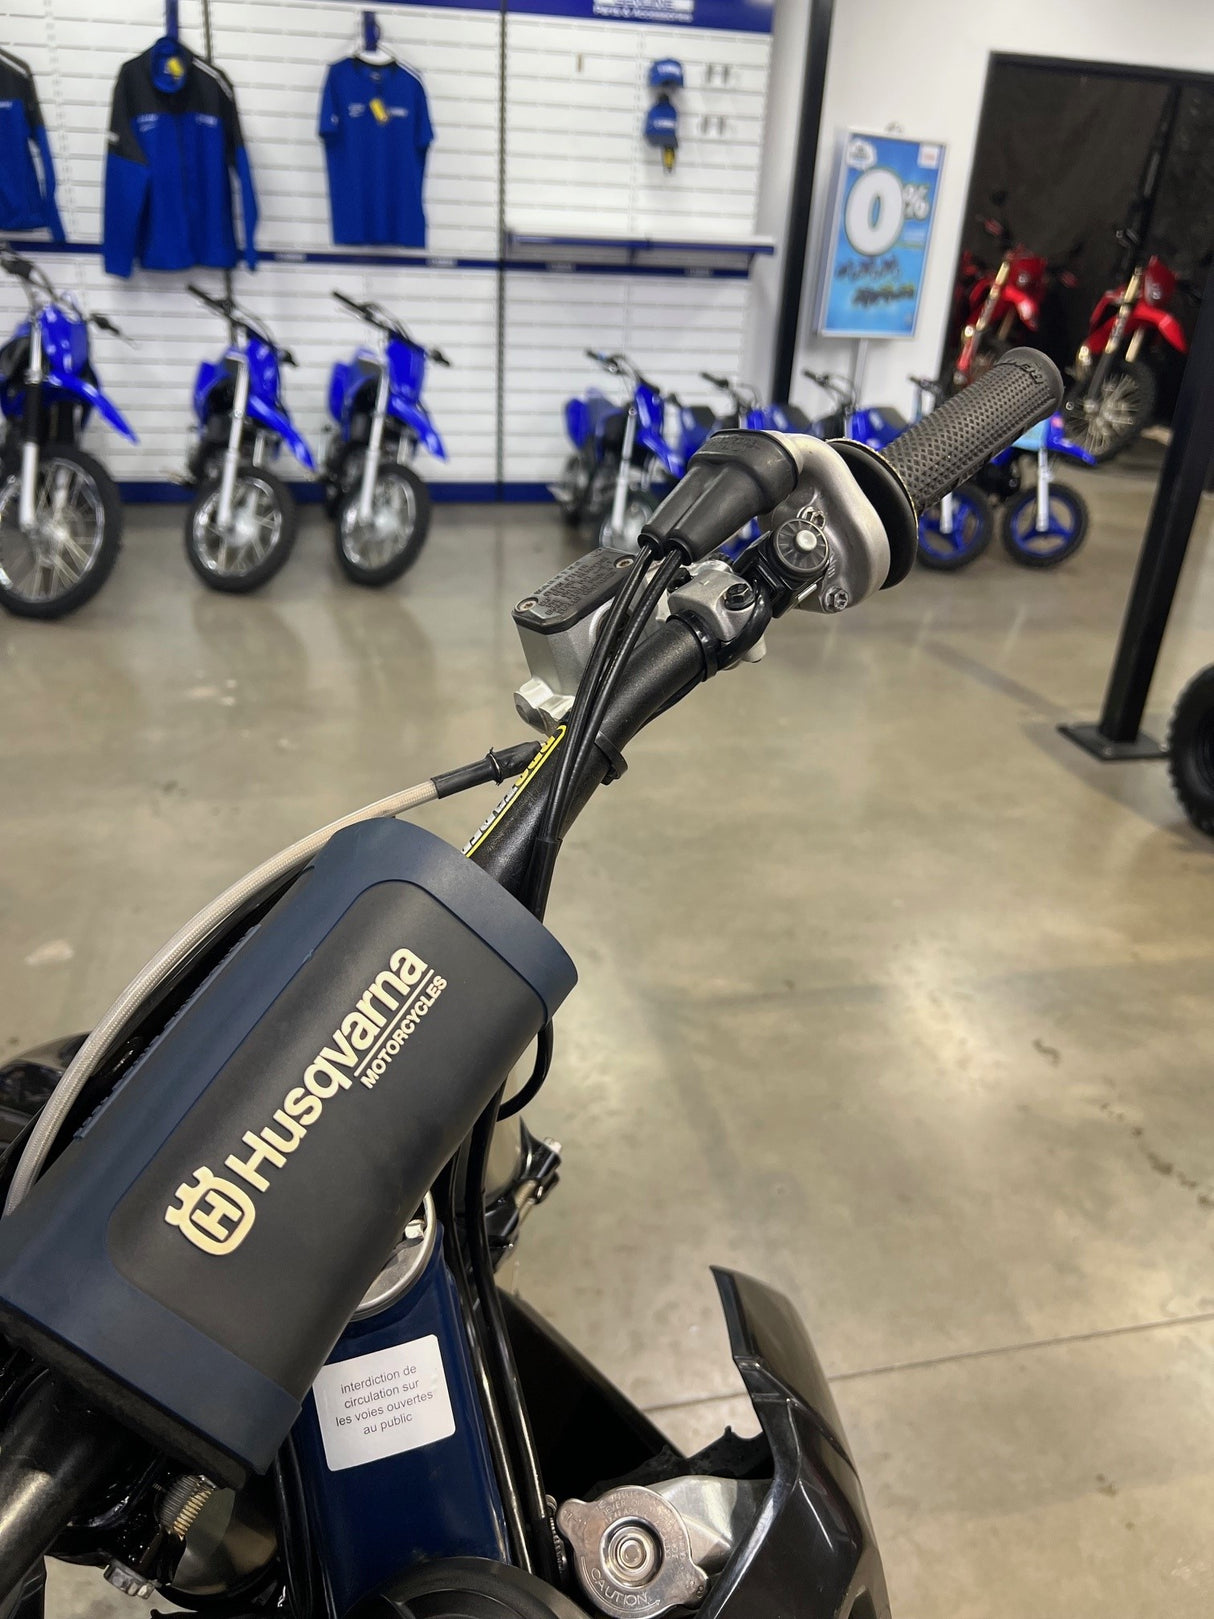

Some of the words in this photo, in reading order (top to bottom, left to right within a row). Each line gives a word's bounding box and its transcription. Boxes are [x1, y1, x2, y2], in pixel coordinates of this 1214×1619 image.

[359, 975, 448, 1089] MOTORCYCLES
[224, 948, 429, 1193] Husqvarna
[341, 1370, 400, 1394] interdiction
[403, 1365, 417, 1376] de
[344, 1386, 400, 1409] circulation
[402, 1380, 419, 1392] sur
[335, 1416, 352, 1427] les
[355, 1406, 384, 1421] voies
[387, 1391, 433, 1412] ouvertes
[363, 1424, 378, 1435] au
[380, 1412, 413, 1432] public
[591, 1567, 650, 1606] CAUTION
